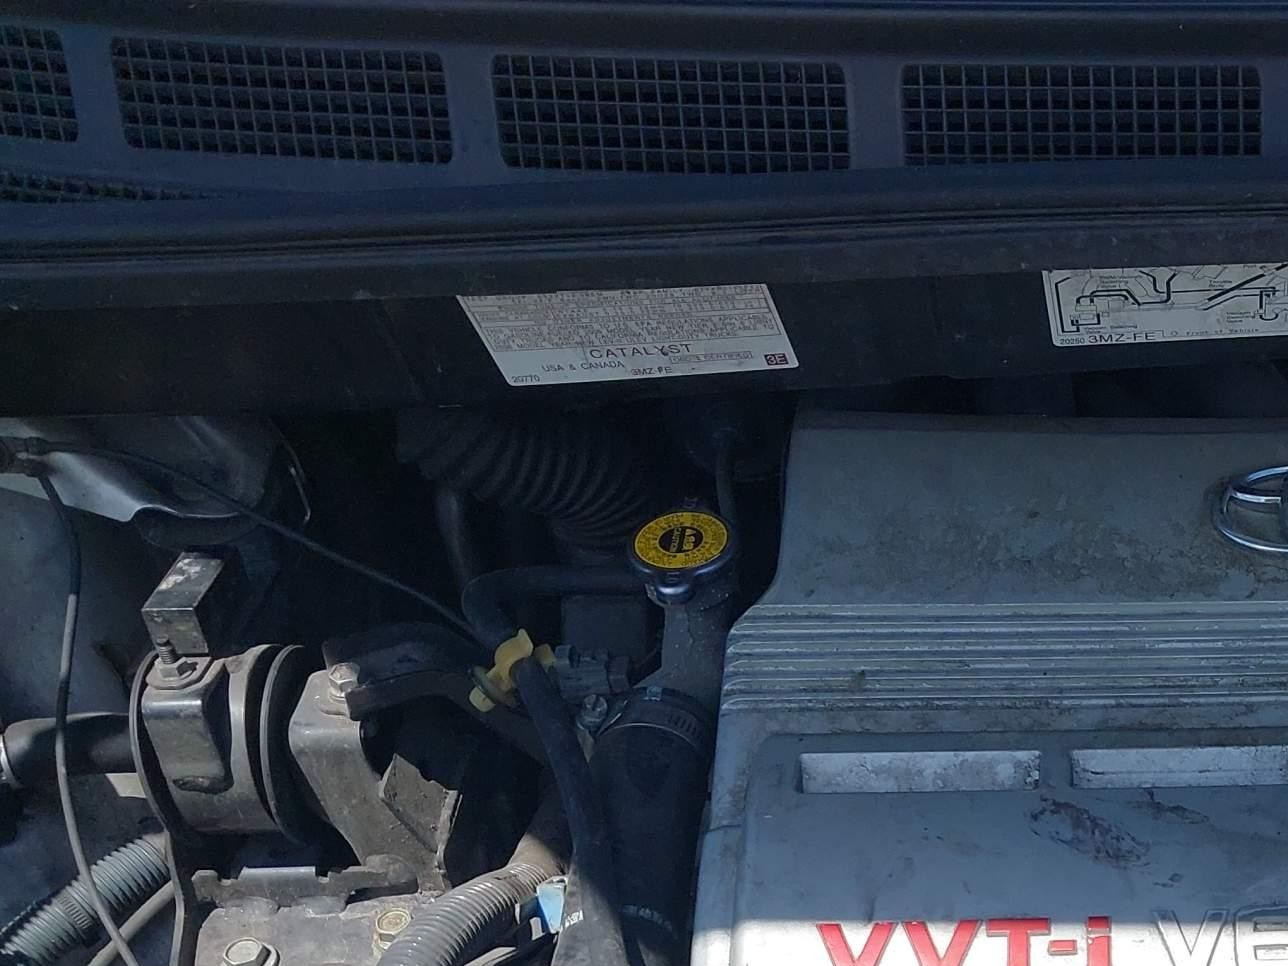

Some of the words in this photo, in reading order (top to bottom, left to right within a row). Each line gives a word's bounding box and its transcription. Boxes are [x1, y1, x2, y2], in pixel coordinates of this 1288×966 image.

[1088, 332, 1156, 345] 3MZ-FE
[589, 343, 692, 359] CATALYST
[766, 353, 787, 365] 3E
[541, 362, 564, 373] USA
[568, 363, 577, 371] &
[580, 360, 625, 371] CANADA
